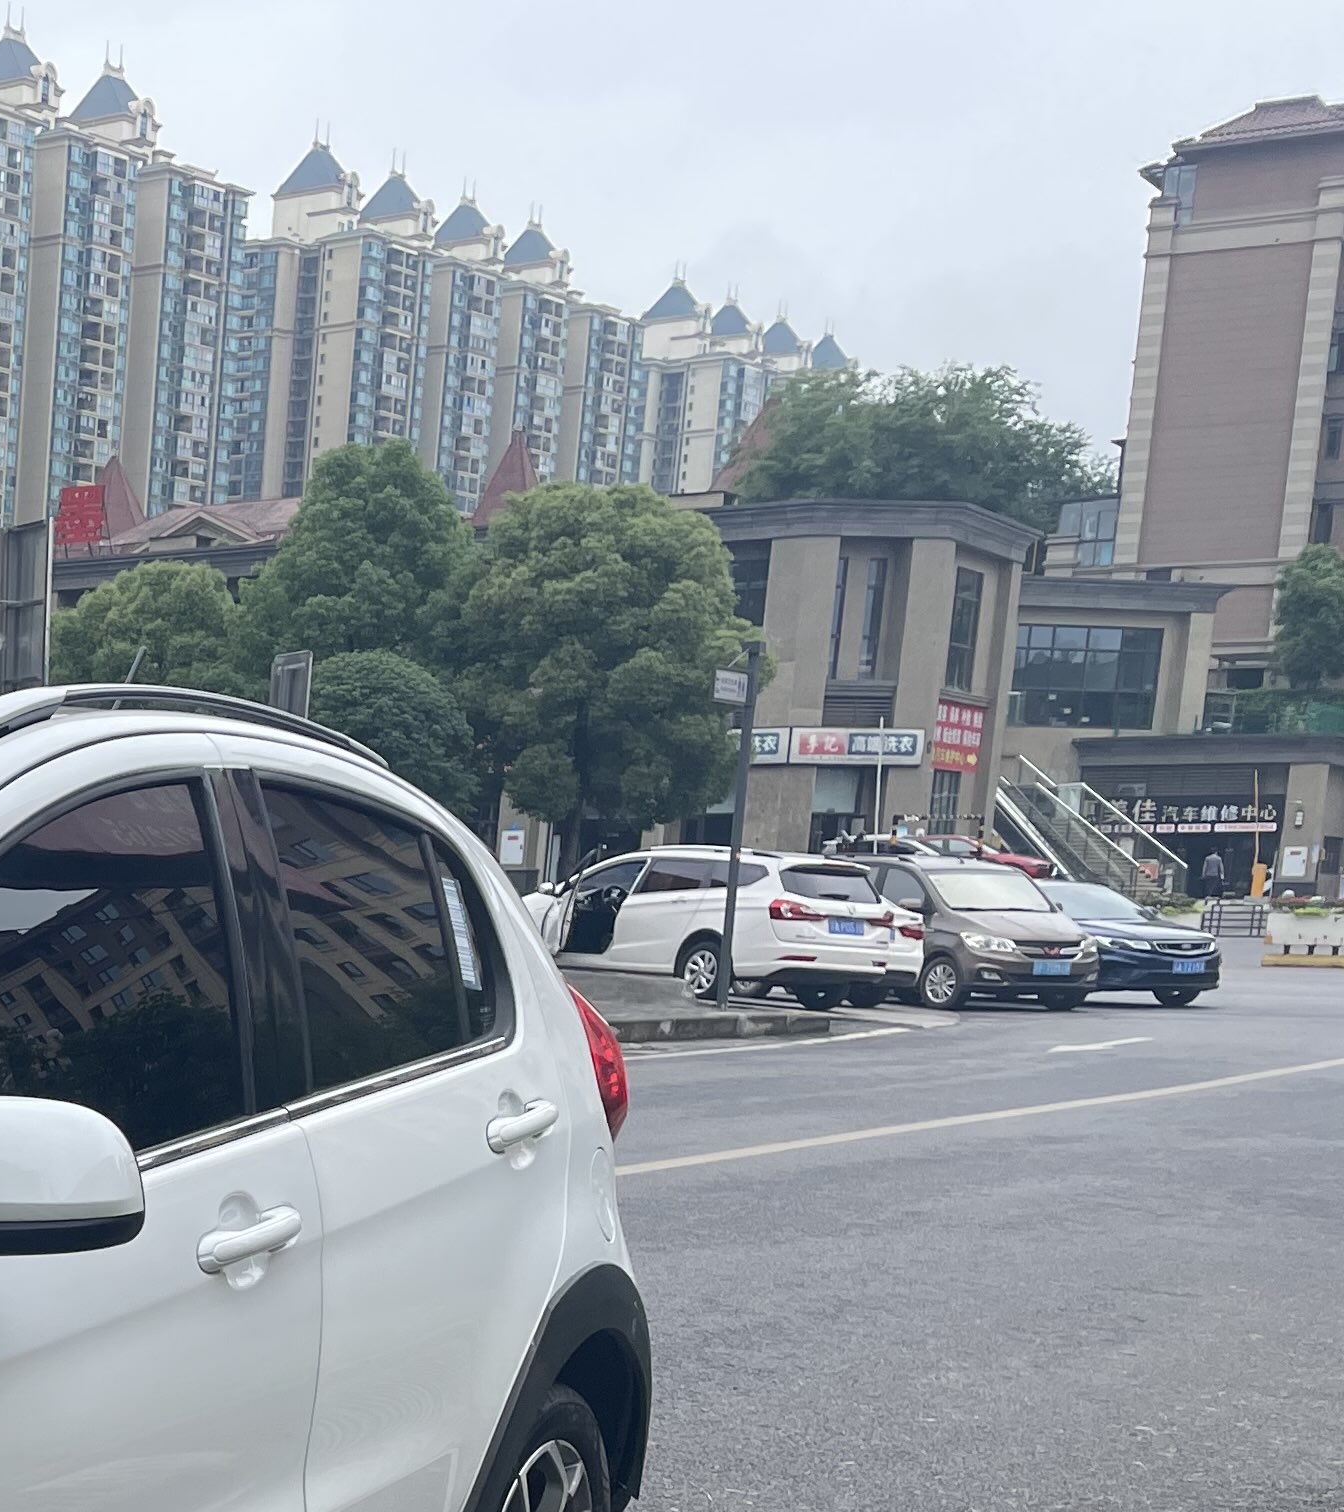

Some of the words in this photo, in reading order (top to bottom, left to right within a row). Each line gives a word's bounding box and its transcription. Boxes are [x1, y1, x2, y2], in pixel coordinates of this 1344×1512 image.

[1161, 803, 1277, 823] 汽车维修中心
